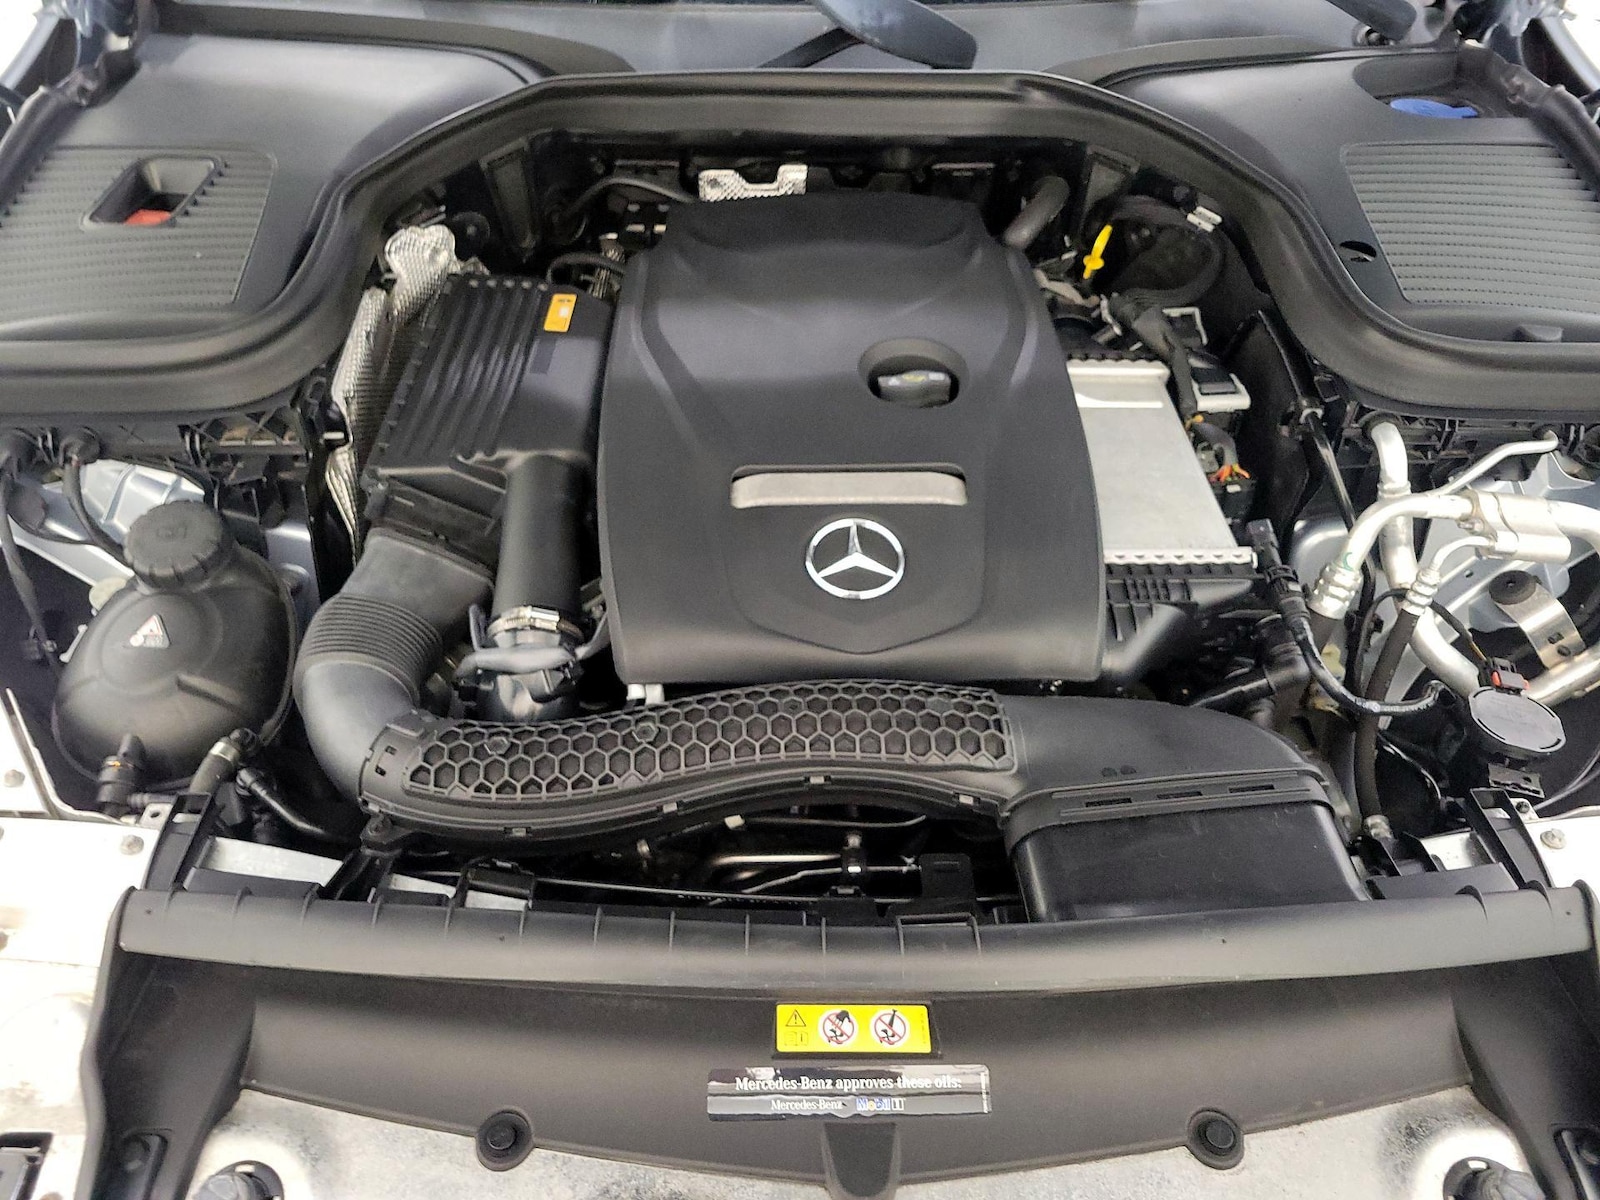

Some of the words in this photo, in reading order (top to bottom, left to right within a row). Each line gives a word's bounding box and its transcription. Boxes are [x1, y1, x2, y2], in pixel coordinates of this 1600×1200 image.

[735, 1076, 833, 1091] Mercedes-Benz
[836, 1077, 894, 1092] approves
[897, 1075, 932, 1089] these
[771, 1099, 843, 1110] Mercedes-Benz
